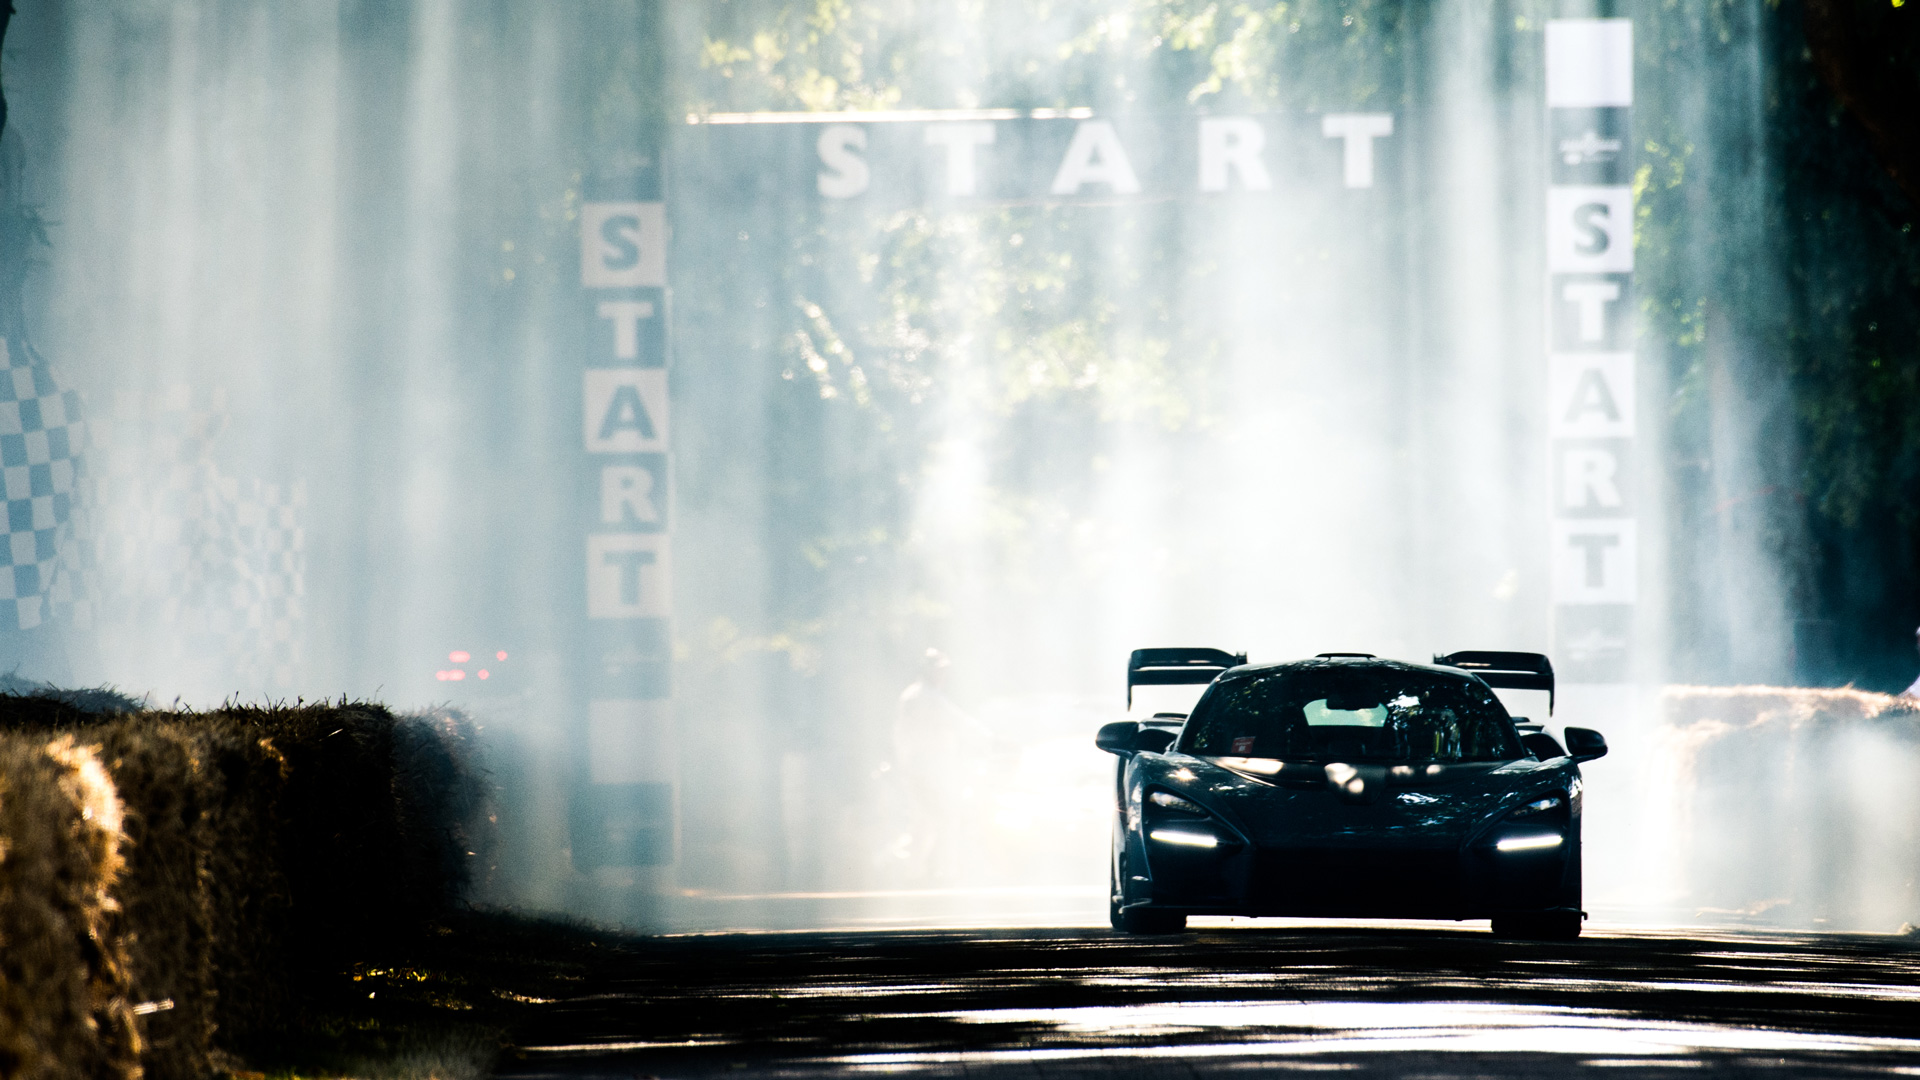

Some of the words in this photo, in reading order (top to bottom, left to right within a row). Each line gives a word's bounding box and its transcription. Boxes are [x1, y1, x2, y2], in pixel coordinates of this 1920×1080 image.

[816, 114, 1394, 199] START
[600, 215, 657, 606] START
[1564, 202, 1622, 589] START
